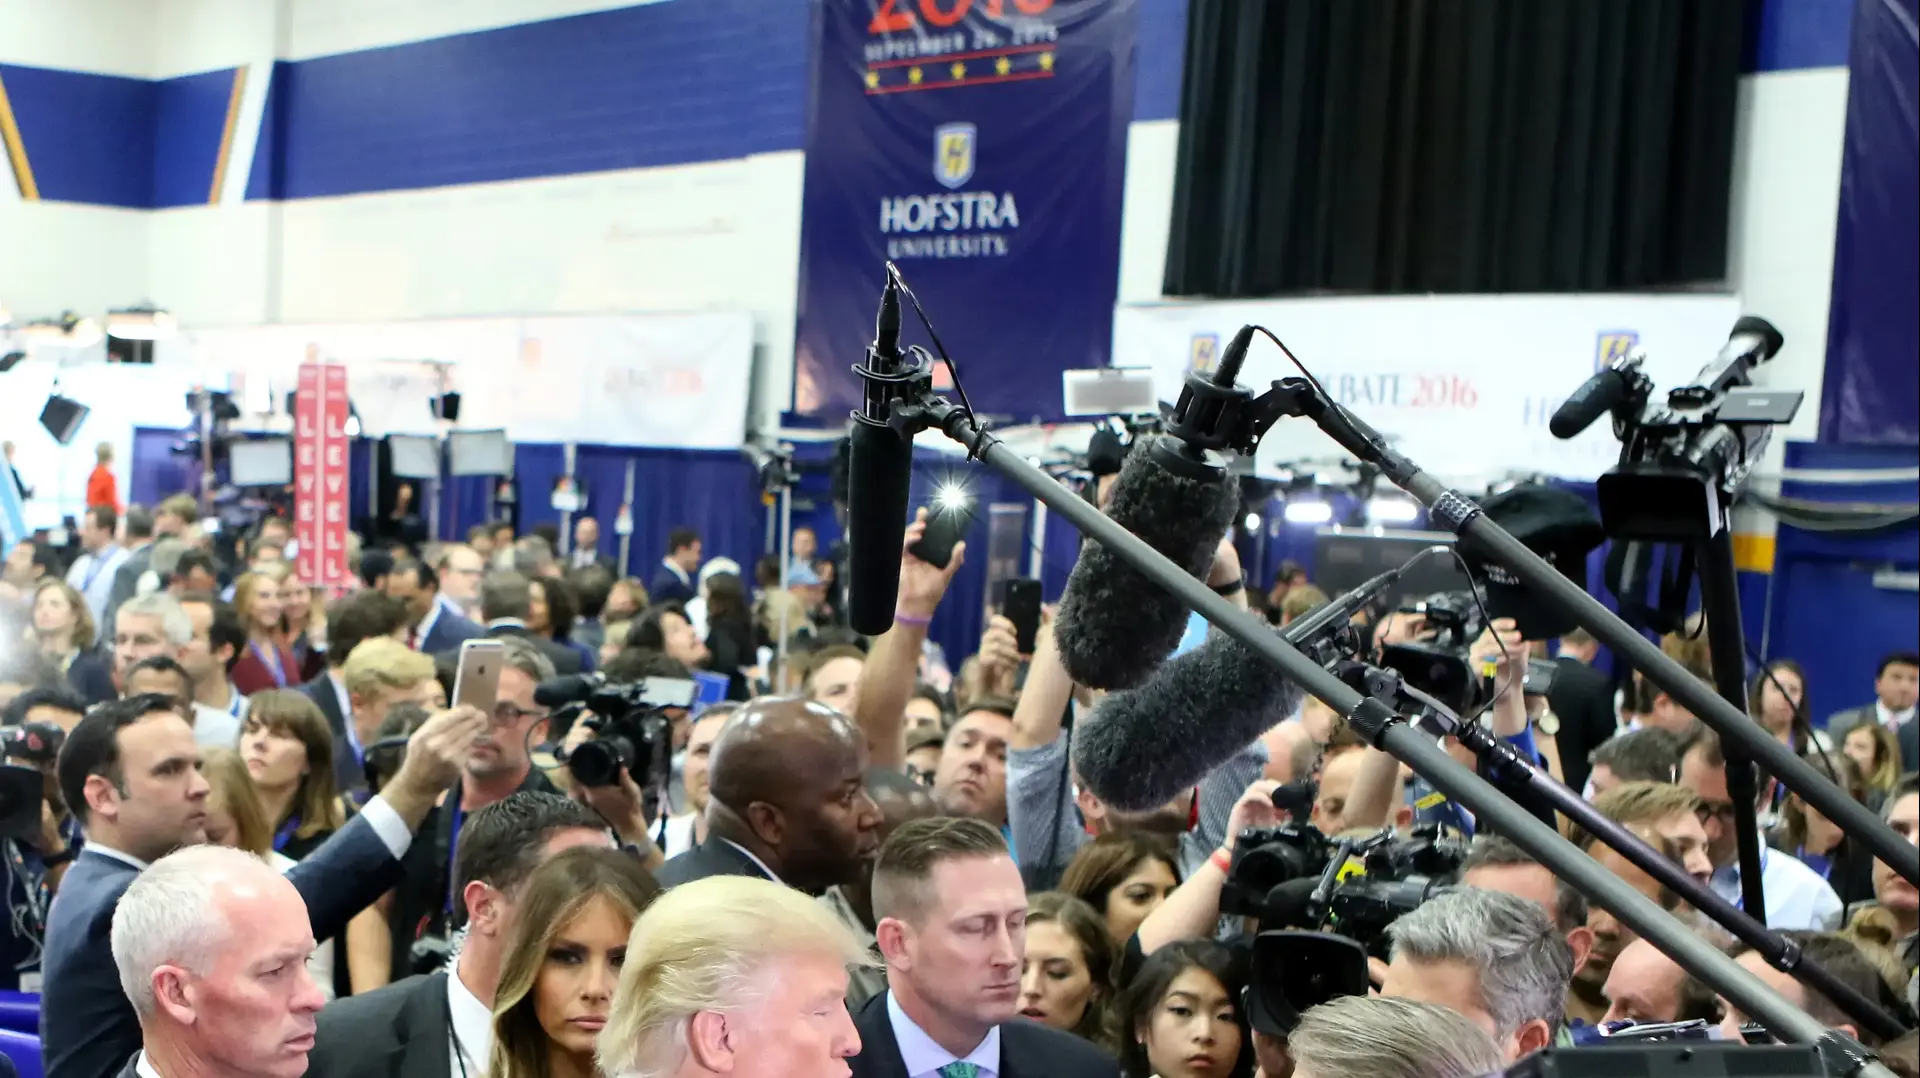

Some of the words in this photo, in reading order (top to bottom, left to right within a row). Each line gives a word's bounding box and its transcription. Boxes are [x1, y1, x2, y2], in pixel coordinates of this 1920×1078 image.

[880, 192, 1019, 232] HOFSTRA
[888, 234, 1008, 258] UNIVERSITY
[1309, 372, 1405, 406] EBATE
[1410, 373, 1478, 409] 2016
